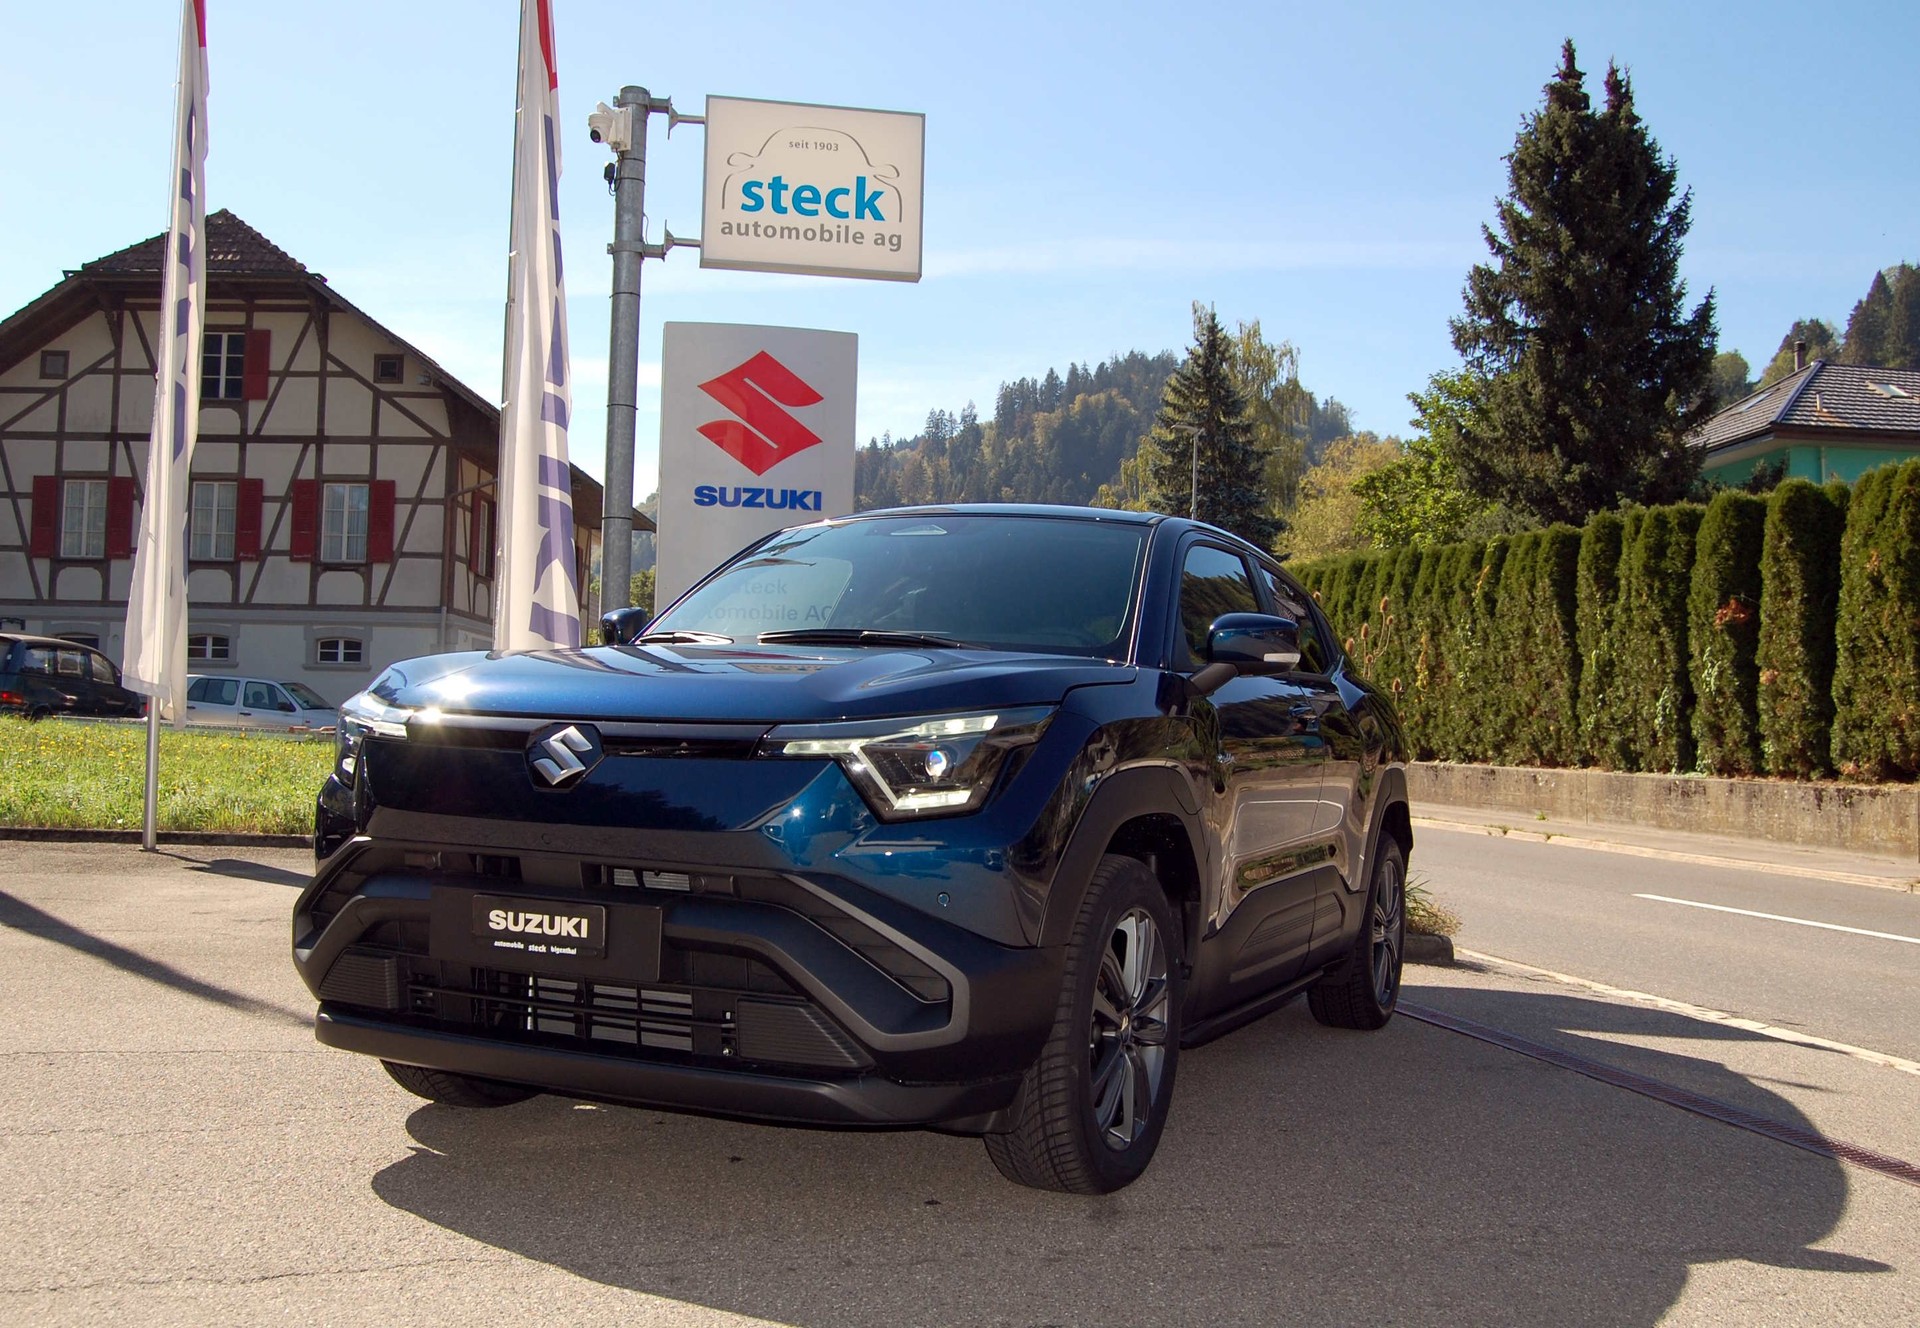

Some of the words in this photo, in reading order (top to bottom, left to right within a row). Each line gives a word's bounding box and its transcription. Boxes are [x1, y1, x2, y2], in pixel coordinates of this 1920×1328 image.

[789, 139, 809, 149] seit
[814, 141, 839, 152] 1903
[740, 175, 886, 221] steck
[720, 220, 865, 245] automobile
[873, 232, 902, 252] ag
[693, 485, 822, 511] SUZUKI
[741, 577, 788, 595] teck
[706, 603, 798, 621] tomobile
[488, 909, 588, 938] SUZUKI
[494, 940, 524, 950] automobile
[528, 943, 547, 953] steck
